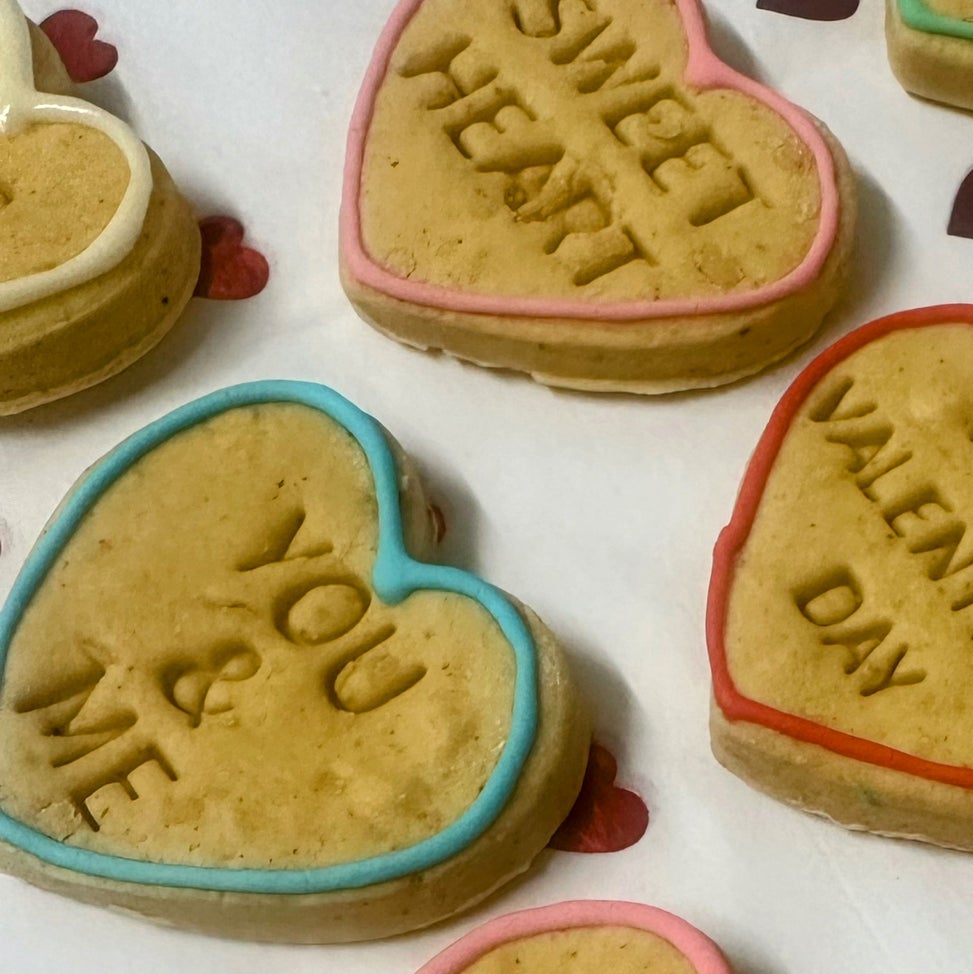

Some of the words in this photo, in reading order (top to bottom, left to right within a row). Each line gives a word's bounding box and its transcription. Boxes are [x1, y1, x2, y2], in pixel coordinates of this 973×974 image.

[400, 35, 657, 287] HEART
[159, 639, 262, 728] &
[236, 507, 427, 714] YOU
[790, 564, 927, 697] DAY
[14, 655, 178, 832] ME
